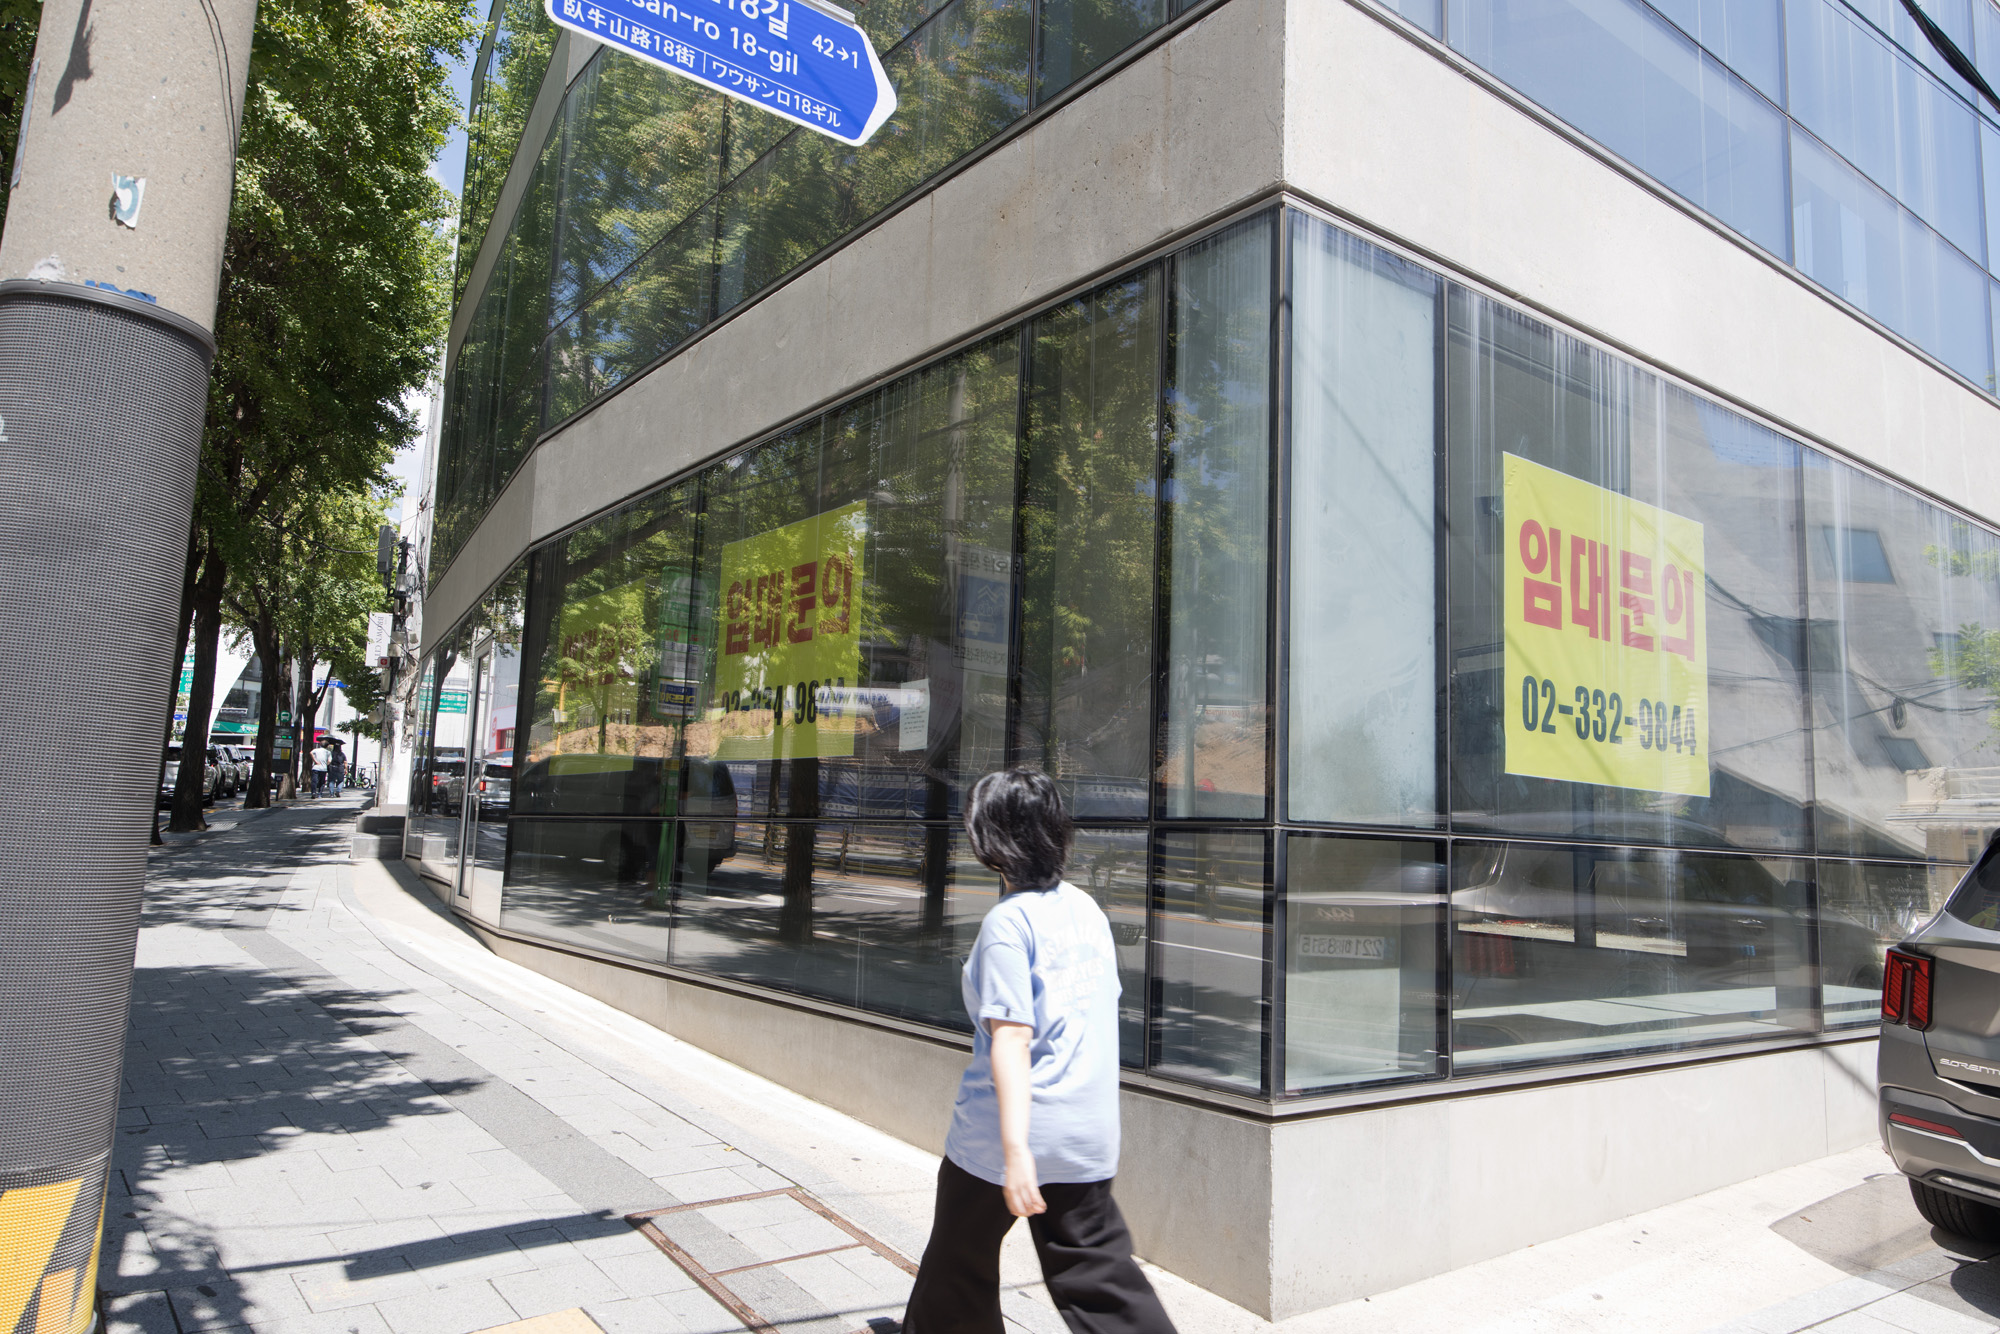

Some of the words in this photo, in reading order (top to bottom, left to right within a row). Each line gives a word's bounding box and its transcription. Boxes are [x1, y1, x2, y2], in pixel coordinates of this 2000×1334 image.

[730, 27, 797, 76] 18-gil
[712, 61, 841, 128] ワウサンロ18ギル
[725, 551, 854, 656] 임대문의
[1519, 518, 1696, 663] 임대문의
[1522, 675, 1697, 756] 02-332-9844
[1939, 1058, 2000, 1076] SORENT
